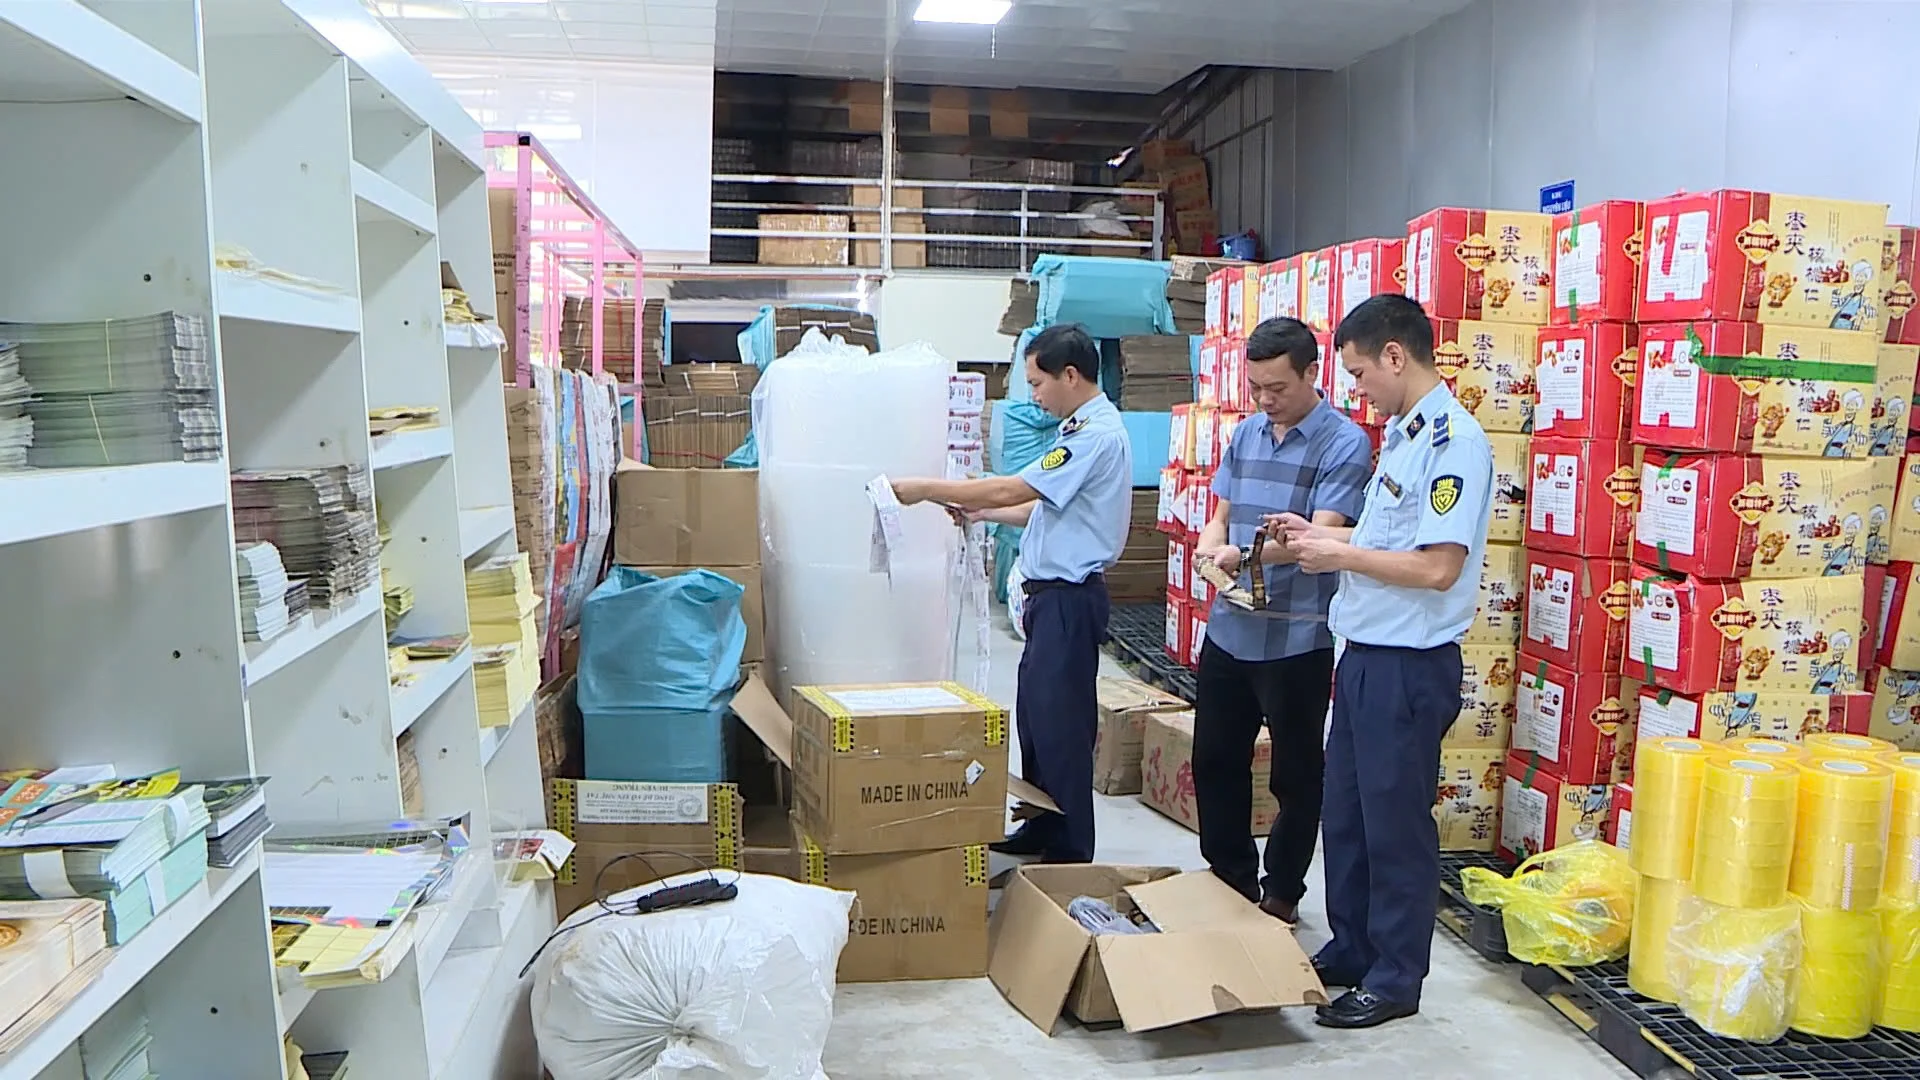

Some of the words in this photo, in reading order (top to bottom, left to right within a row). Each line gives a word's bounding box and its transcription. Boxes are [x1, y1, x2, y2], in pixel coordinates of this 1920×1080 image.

[861, 784, 903, 804] MADE
[907, 783, 921, 801] IN
[924, 781, 969, 800] CHINA
[881, 919, 896, 934] IN
[900, 916, 945, 934] CHINA
